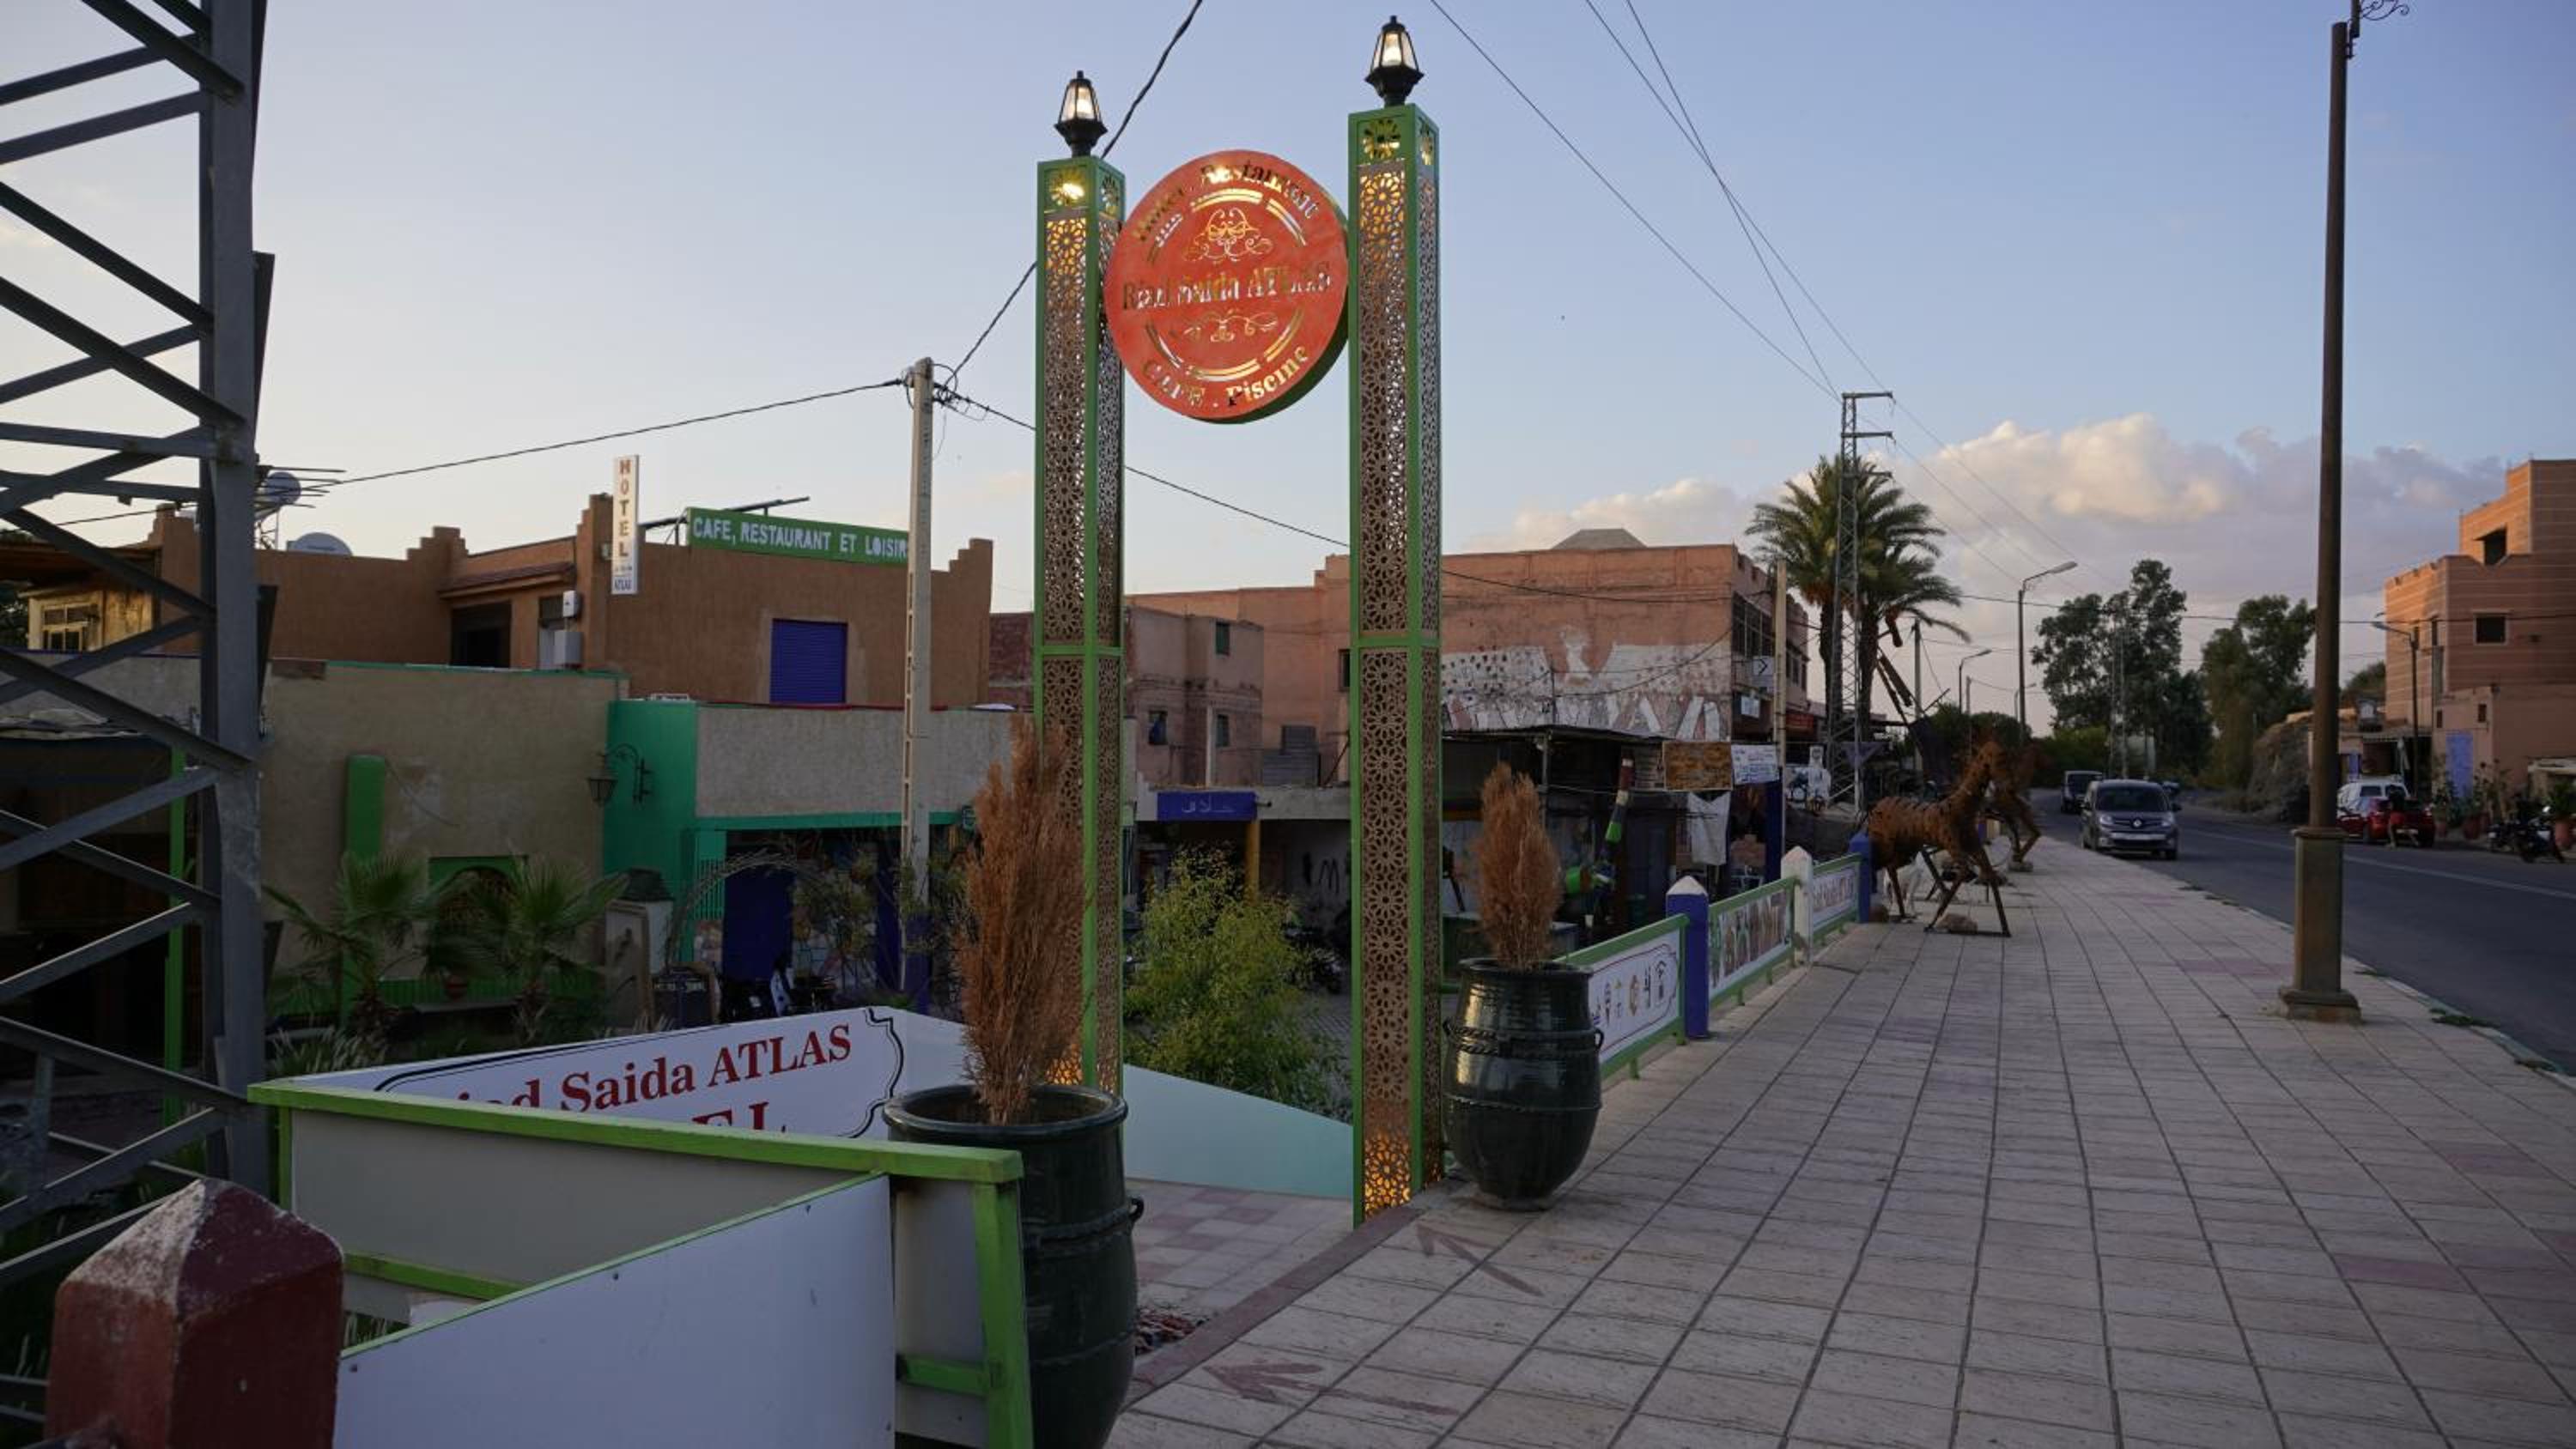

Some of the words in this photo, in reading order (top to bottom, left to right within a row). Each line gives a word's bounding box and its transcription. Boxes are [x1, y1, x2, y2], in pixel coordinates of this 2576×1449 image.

[1224, 345, 1309, 407] Piscine
[619, 459, 631, 557] HOTEL
[693, 517, 736, 545] CAFE,
[741, 521, 832, 550] RESTAURANT
[839, 533, 858, 553] ET
[561, 1056, 695, 1113] Saida
[708, 1024, 852, 1088] ATLAS
